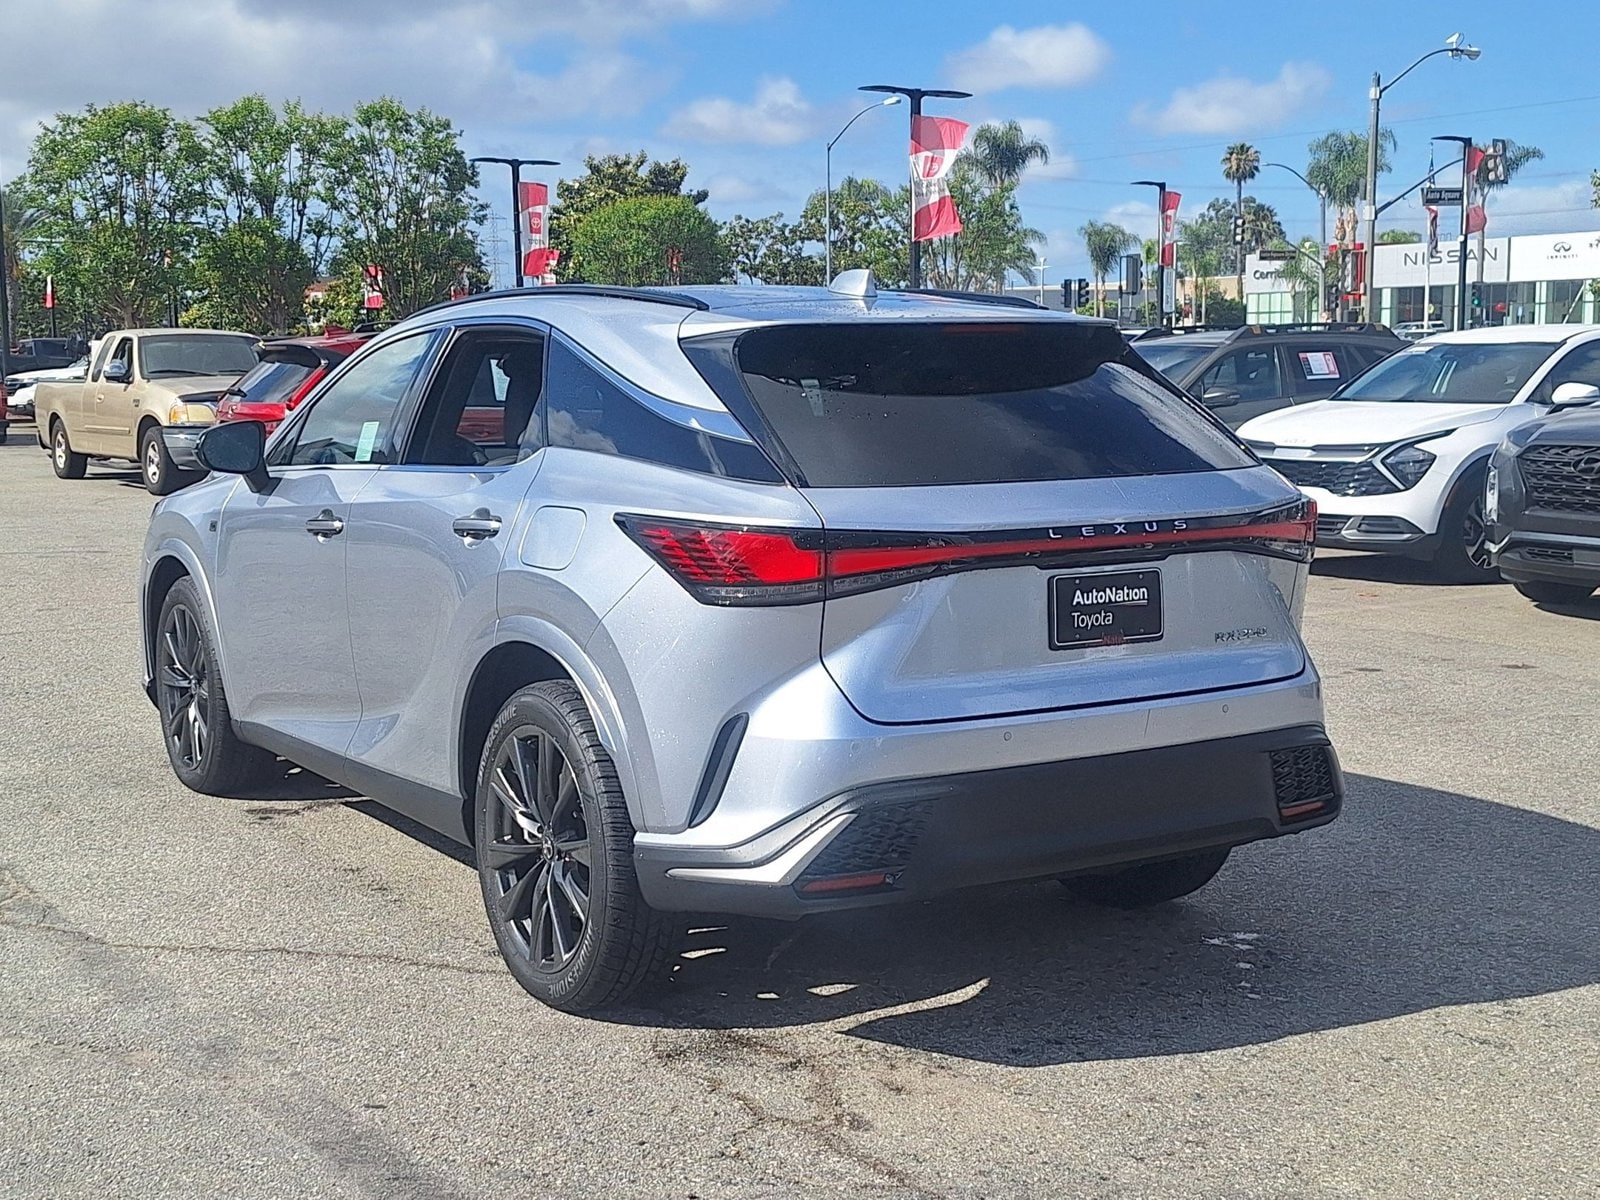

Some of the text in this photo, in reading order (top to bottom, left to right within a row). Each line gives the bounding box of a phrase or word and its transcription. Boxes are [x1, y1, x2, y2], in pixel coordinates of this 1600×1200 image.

[1404, 247, 1498, 266] NISSAN
[1253, 267, 1287, 280] Cerri
[1048, 519, 1188, 539] LEXUS
[1072, 585, 1148, 606] AutoNation
[1071, 609, 1114, 630] Toyota
